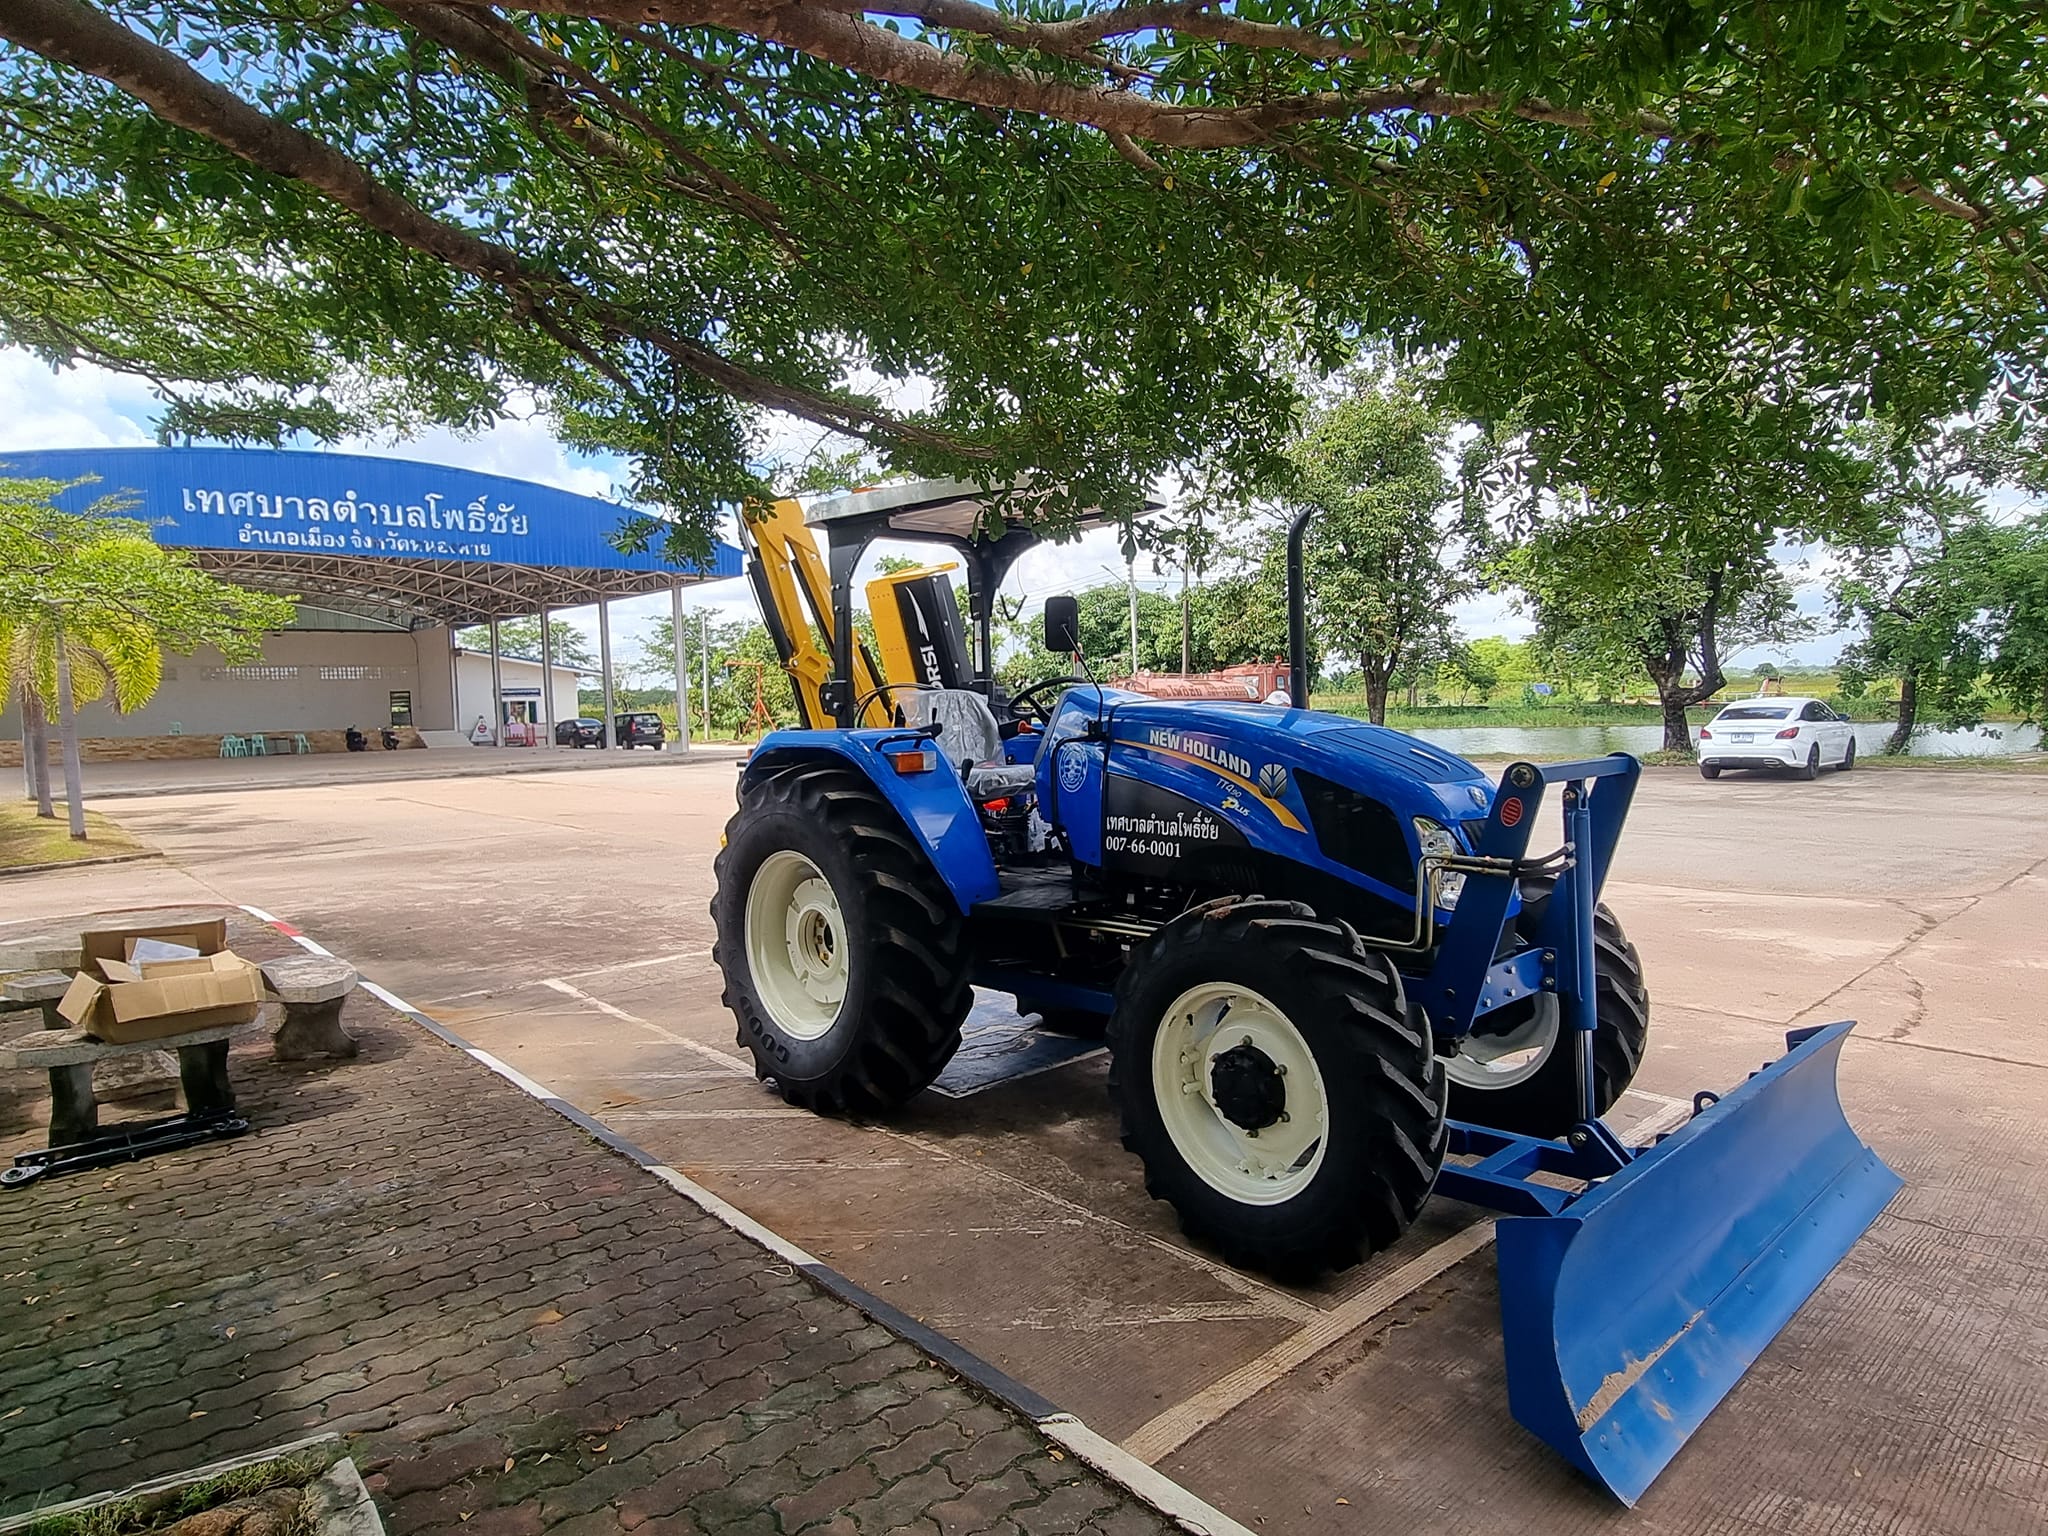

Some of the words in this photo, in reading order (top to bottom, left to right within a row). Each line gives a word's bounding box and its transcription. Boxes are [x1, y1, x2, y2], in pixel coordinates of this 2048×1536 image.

[182, 488, 528, 536] เทศบาลตำบลโพธิ์ชัย
[238, 524, 346, 548] อำเภอเมือง
[1149, 729, 1180, 751] NEW
[1183, 737, 1251, 778] HOLLAND
[1106, 811, 1219, 840] เทศบาลตำบลโพธิ์ชัย
[1106, 836, 1181, 858] 007-66-0001
